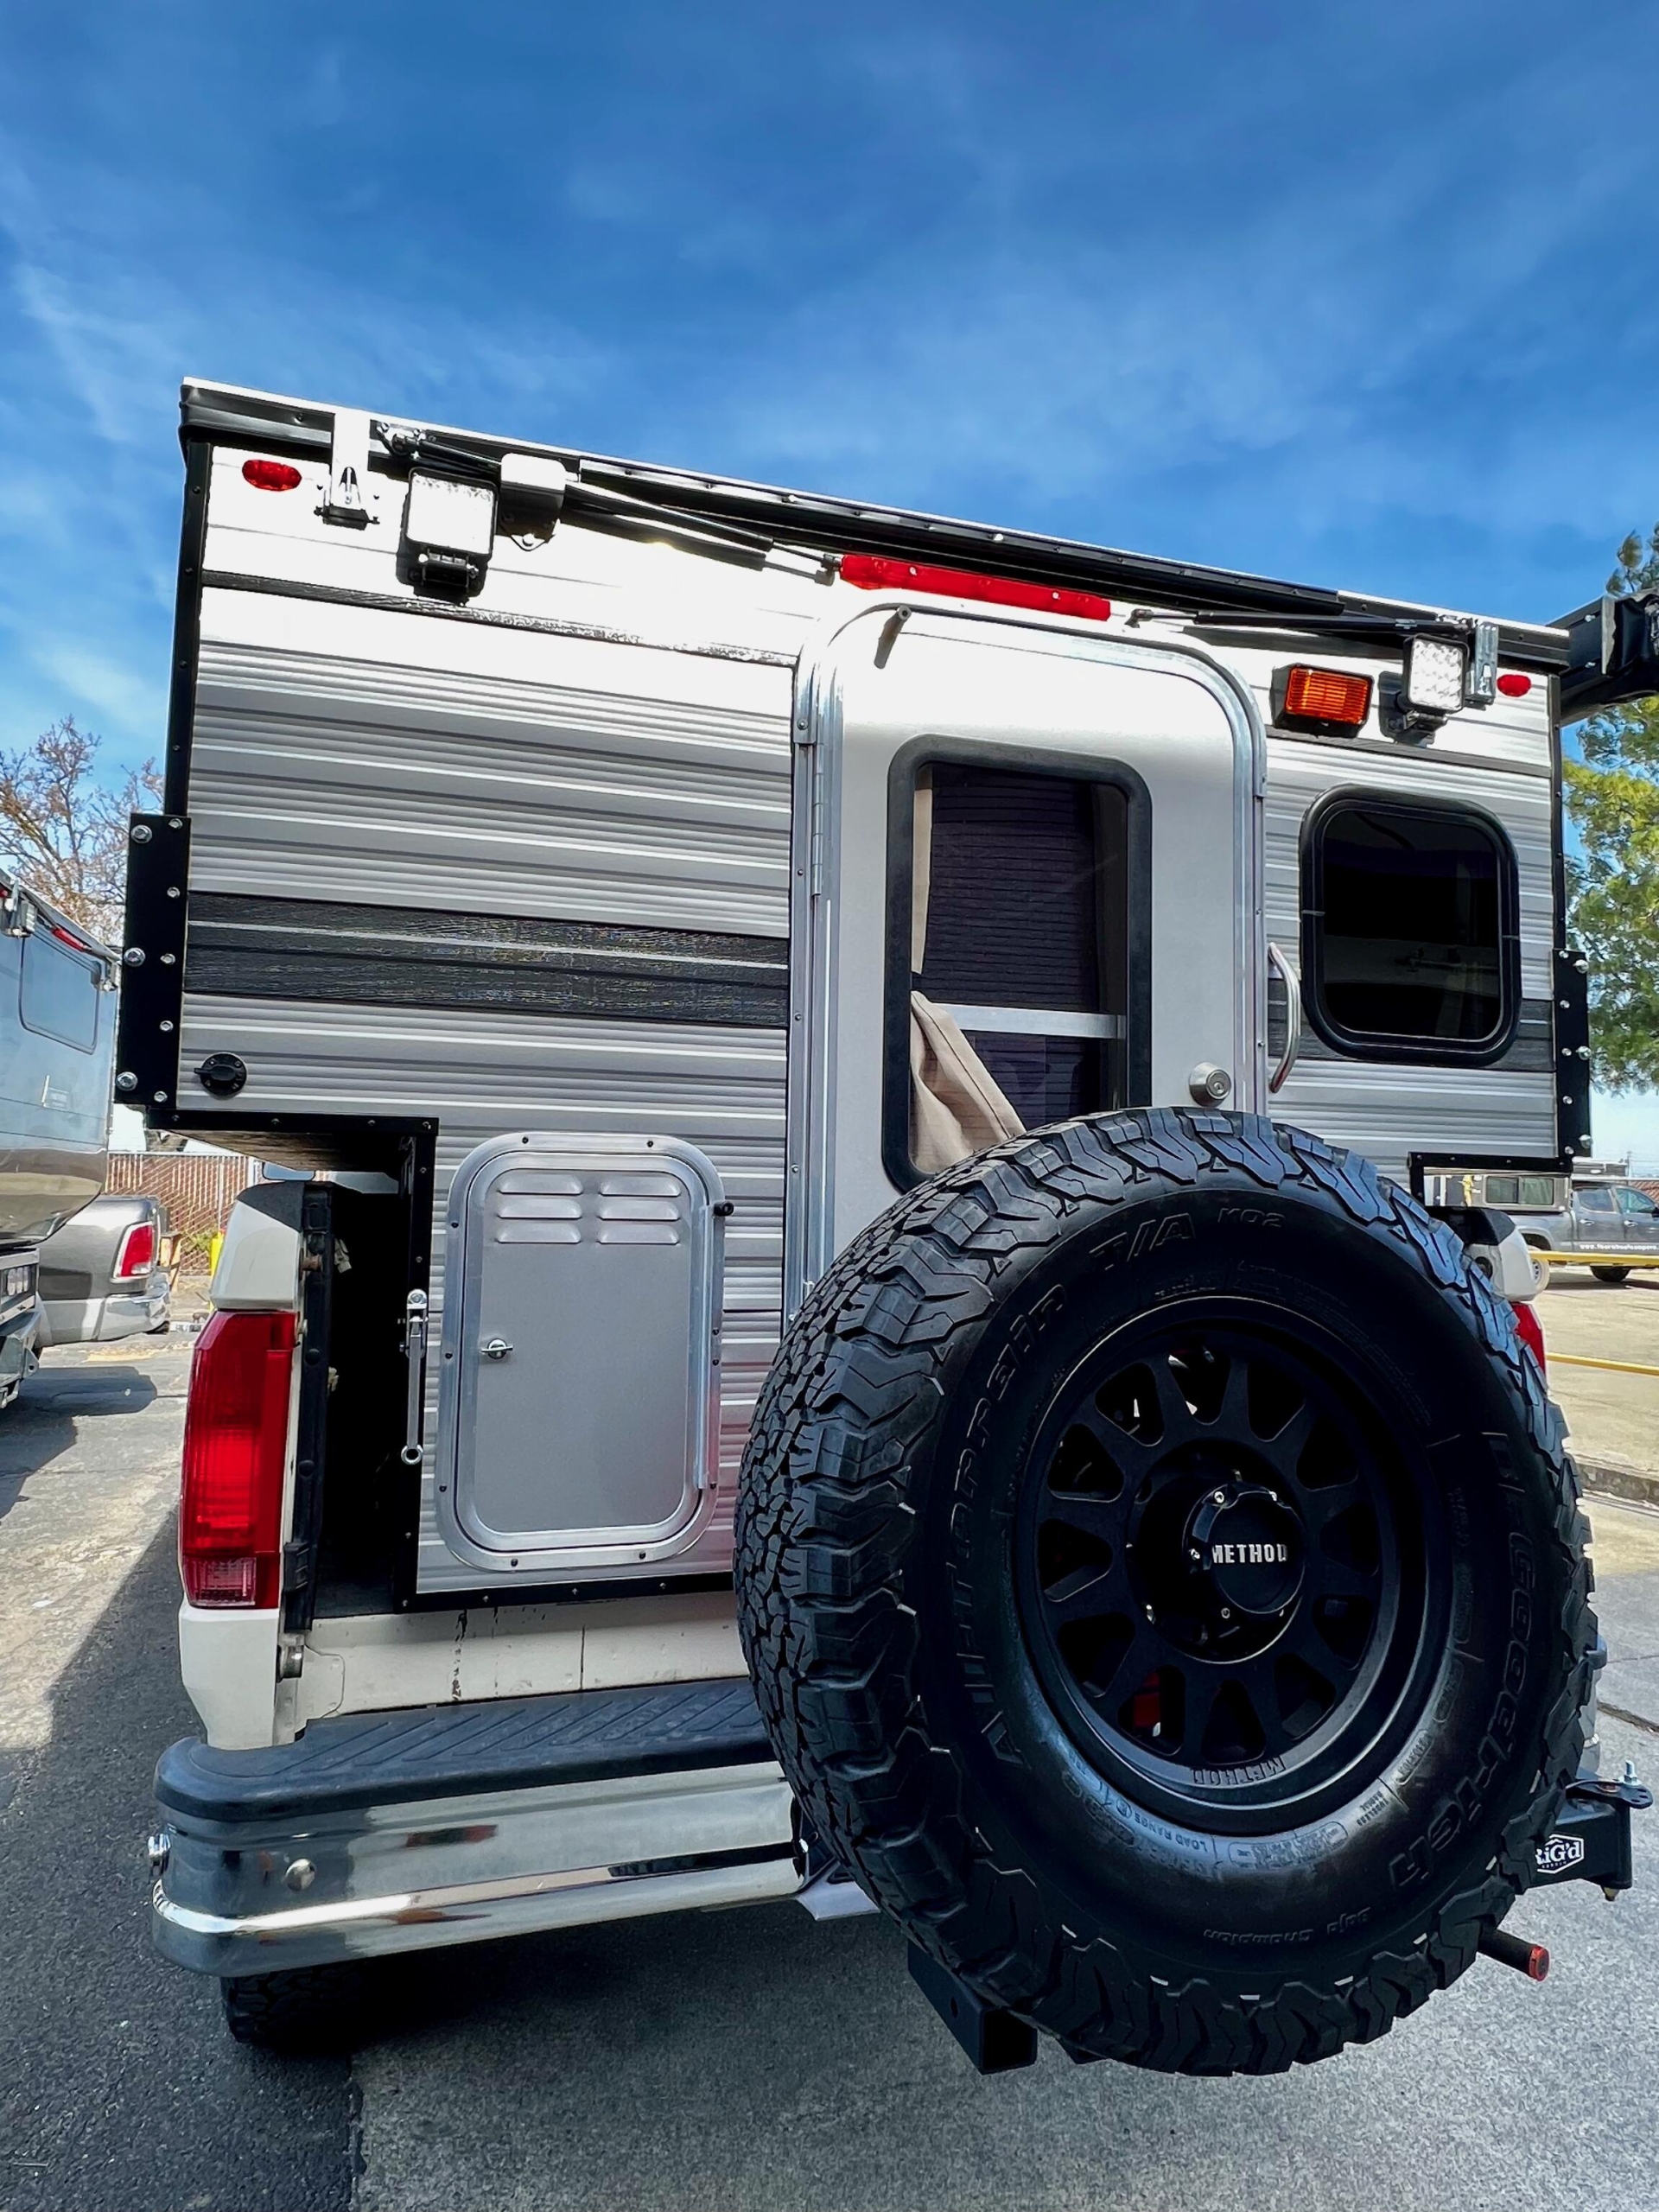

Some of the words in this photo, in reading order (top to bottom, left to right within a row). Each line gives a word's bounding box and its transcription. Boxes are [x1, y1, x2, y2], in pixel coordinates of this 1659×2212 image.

[1087, 1211, 1198, 1274] T/A
[1217, 1207, 1287, 1229] KO2
[1211, 1543, 1288, 1564] METHOD
[1193, 1755, 1287, 1786] METHOD
[1135, 1811, 1173, 1841] RANGE
[1175, 1834, 1209, 1853] LOAD
